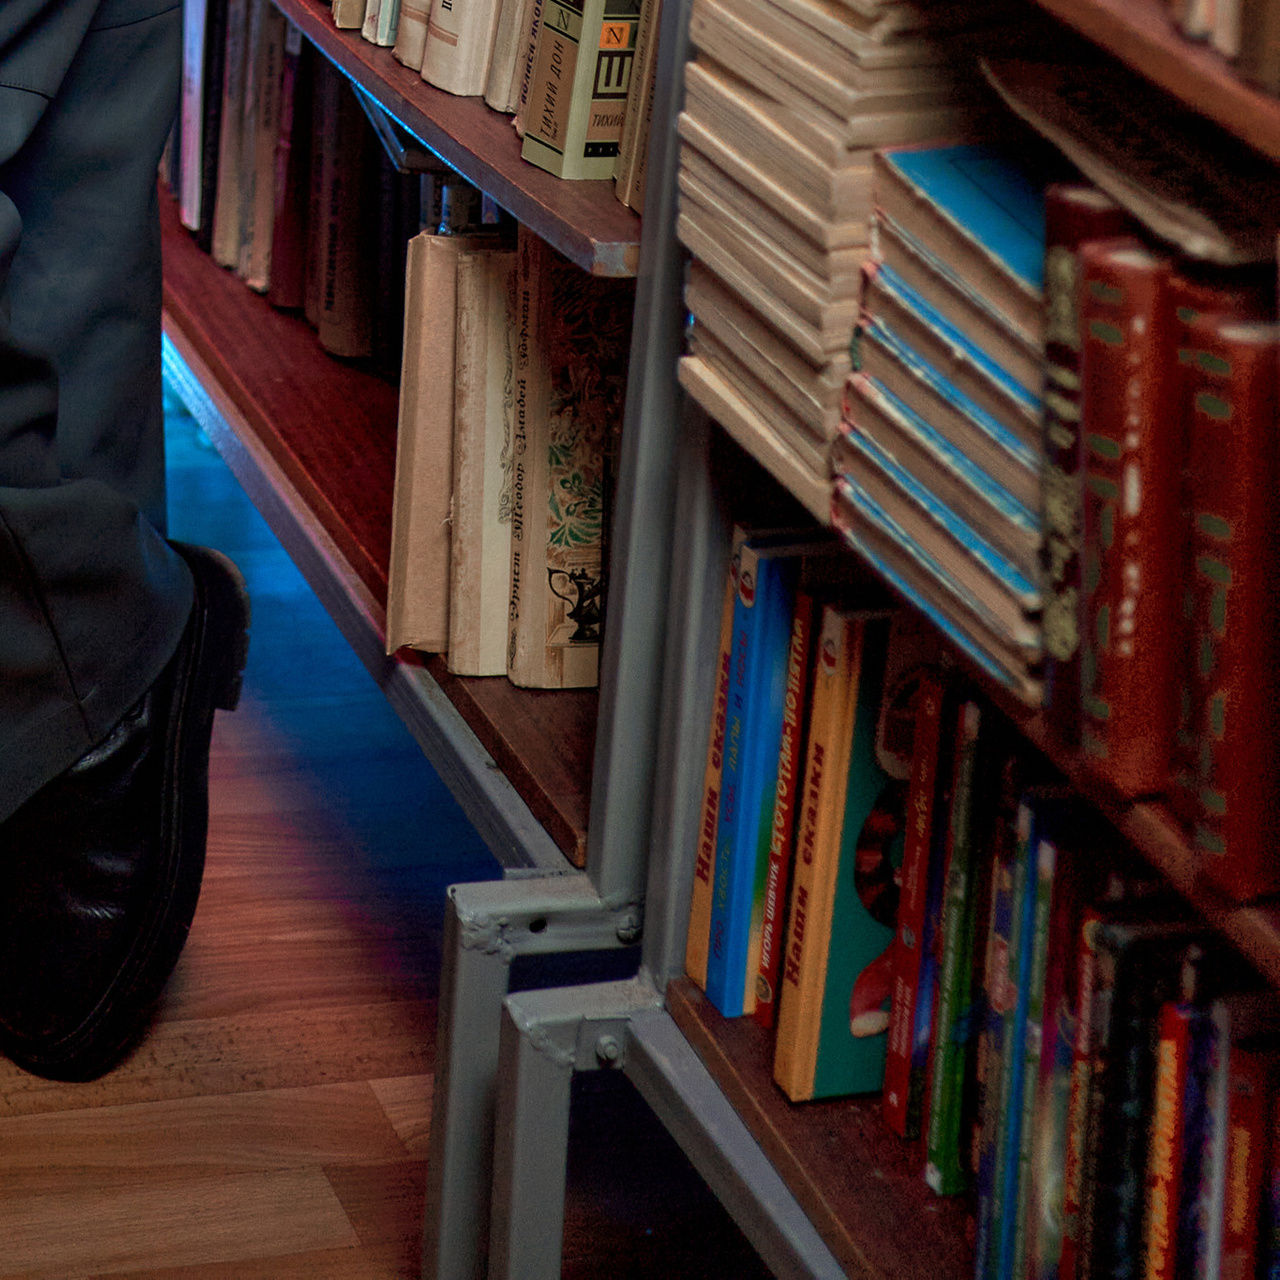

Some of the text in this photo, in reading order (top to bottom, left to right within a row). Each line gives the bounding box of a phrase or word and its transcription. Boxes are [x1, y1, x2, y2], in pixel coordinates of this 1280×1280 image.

[539, 39, 565, 139] ТИХИЙ ДОН
[696, 650, 732, 887] Наши сказки
[765, 862, 781, 921] ШЕВЧУК
[784, 742, 825, 988] Наши сказки
[761, 923, 775, 970] ИГОРЬ
